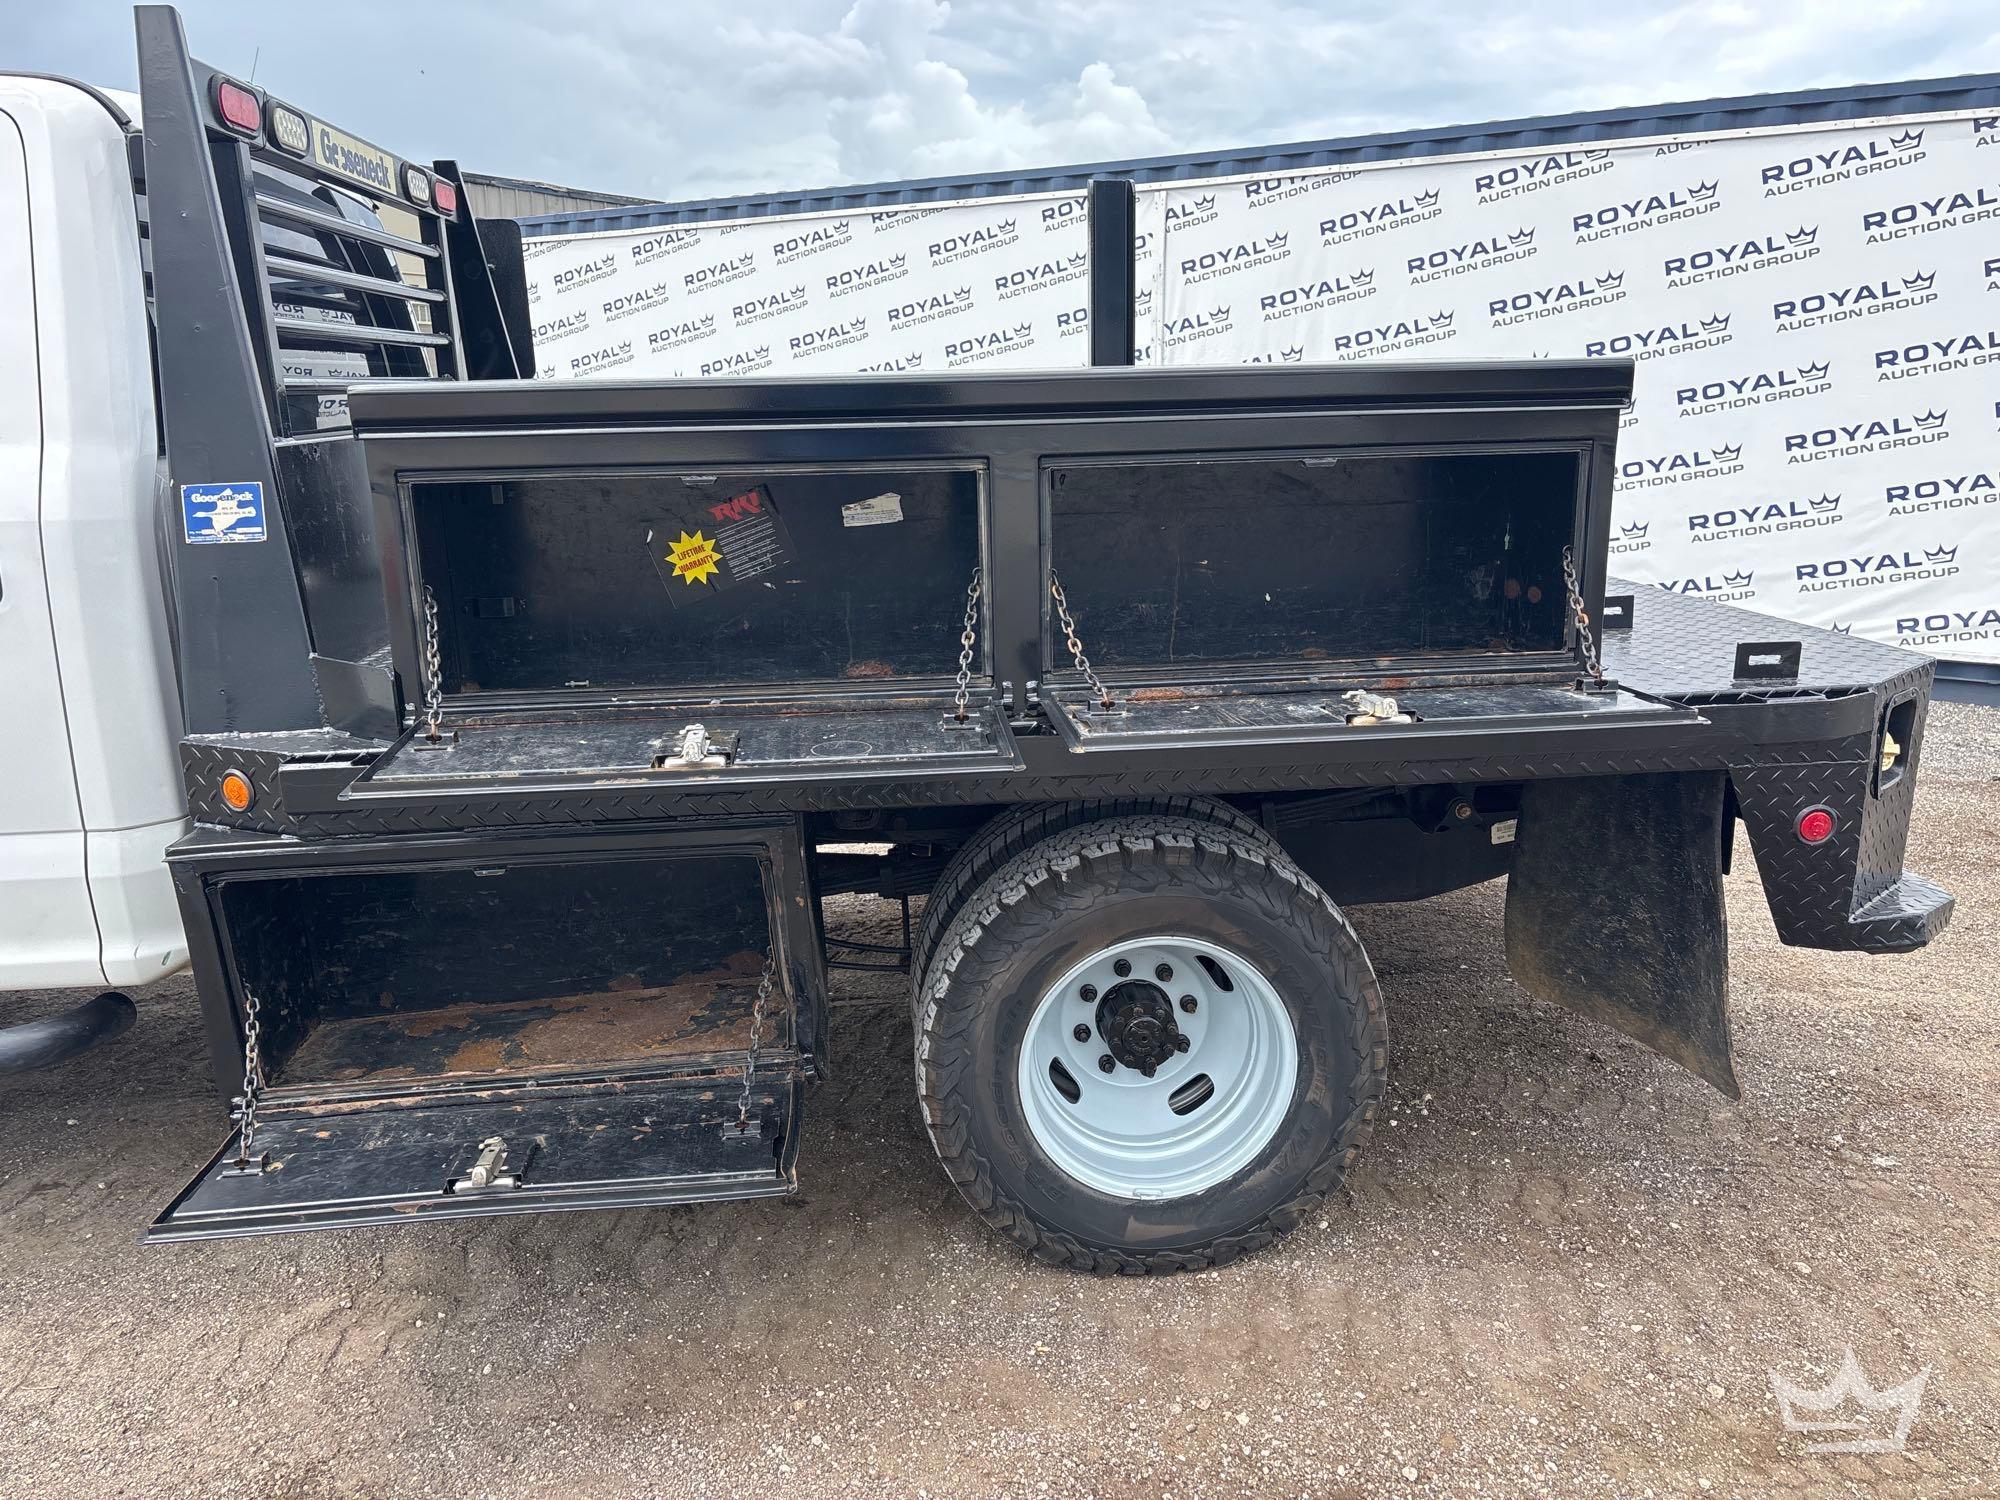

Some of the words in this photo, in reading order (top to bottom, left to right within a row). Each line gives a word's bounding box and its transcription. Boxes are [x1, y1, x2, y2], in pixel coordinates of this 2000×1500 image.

[1475, 152, 1582, 192] ROYAL
[1762, 142, 1888, 184] ROYAL
[1764, 170, 1850, 198] AUCTION
[1856, 152, 1926, 176] GROUP
[1249, 184, 1308, 209] AUCTION
[1479, 178, 1550, 205] AUCTION
[1554, 162, 1614, 184] GROUP
[875, 213, 919, 233] AUCTION
[1042, 197, 1088, 222] ROY
[1045, 214, 1086, 232] AUCTIO
[1174, 212, 1218, 231] GROUP
[1320, 200, 1414, 236] ROYAL
[1574, 192, 1686, 232] ROYAL
[1576, 218, 1652, 244] AUCTION
[1657, 202, 1720, 224] GROUP
[1864, 189, 1997, 231] ROYAL
[1323, 224, 1386, 247] AUCTION
[1390, 208, 1442, 229] GROUP
[1866, 217, 1956, 245] AUCTION
[632, 230, 684, 257] ROYAL
[635, 249, 670, 266] AUCTION
[672, 238, 700, 253] GROUP
[774, 228, 834, 256] ROYAL
[777, 247, 817, 266] AUCTION
[819, 236, 852, 251] GROUP
[929, 227, 998, 257] ROYAL
[932, 248, 978, 267] AUCTION
[980, 235, 1018, 252] GROUP
[1408, 238, 1507, 274] ROYAL
[1182, 242, 1266, 274] ROYAL
[1184, 264, 1241, 285] AUCTION
[1244, 250, 1290, 268] GROUP
[1411, 262, 1478, 285] AUCTION
[1482, 248, 1537, 268] GROUP
[1665, 237, 1784, 276] ROYAL
[1668, 264, 1748, 289] AUCTION
[1754, 248, 1820, 269] GROUP
[554, 261, 602, 286] ROYAL
[557, 278, 589, 294] AUCTION
[590, 268, 617, 282] GROUP
[684, 260, 739, 286] ROYAL
[688, 278, 724, 295] AUCTION
[726, 267, 756, 282] GROUP
[826, 262, 889, 289] ROYAL
[830, 280, 872, 299] AUCTION
[874, 269, 908, 285] GROUP
[996, 260, 1068, 290] ROYAL
[999, 281, 1047, 301] AUCTION
[1050, 269, 1088, 286] GROUP
[603, 290, 653, 314] ROYAL
[733, 292, 790, 318] ROYAL
[888, 294, 954, 322] ROYAL
[1261, 278, 1350, 310] ROYAL
[1264, 300, 1324, 322] AUCTION
[1327, 288, 1376, 306] GROUP
[1489, 281, 1594, 316] ROYAL
[1774, 282, 1900, 320] ROYAL
[606, 307, 640, 322] AUCTION
[641, 297, 668, 310] GROUP
[736, 311, 774, 328] AUCTION
[776, 300, 808, 315] GROUP
[892, 313, 935, 331] AUCTION
[937, 302, 974, 318] GROUP
[1492, 306, 1563, 328] AUCTION
[1567, 291, 1626, 311] GROUP
[1776, 308, 1862, 333] AUCTION
[1868, 293, 1937, 314] GROUP
[564, 324, 589, 336] GROUP
[649, 321, 700, 345] ROYAL
[790, 324, 850, 350] ROYAL
[1163, 315, 1208, 334] YAL
[1189, 324, 1232, 341] GROUP
[1335, 320, 1428, 351] ROYAL
[652, 338, 686, 354] AUCTION
[688, 328, 716, 342] GROUP
[793, 342, 833, 359] AUCTION
[835, 332, 868, 347] GROUP
[945, 330, 1013, 357] ROYAL
[948, 350, 994, 368] AUCTION
[996, 339, 1034, 354] GROUP
[1339, 342, 1401, 360] AUCTION
[1404, 330, 1456, 347] GROUP
[1586, 324, 1699, 357] ROYAL
[1669, 335, 1732, 354] GROUP
[571, 347, 619, 370] ROYAL
[574, 364, 606, 378] AUCTION
[608, 354, 634, 367] GROUP
[701, 352, 755, 376] ROYAL
[1878, 358, 1968, 382] AUCTION
[1677, 371, 1796, 405] ROYAL
[1680, 396, 1760, 417] AUCTION
[1765, 383, 1831, 402] GROUP
[1786, 418, 1912, 452] ROYAL
[1788, 443, 1873, 464] AUCTION
[1879, 431, 1949, 450] GROUP
[1613, 475, 1677, 492] UCTION
[1681, 464, 1744, 481] GROUP
[1886, 474, 1996, 503] ROYA
[1689, 502, 1807, 530] ROYAL
[1889, 496, 1978, 516] AUCTION
[1692, 525, 1771, 543] AUCTION
[1776, 515, 1842, 531] GROUP
[677, 545, 705, 561] LIFETIME
[679, 554, 714, 574] WARRANTY
[1796, 552, 1922, 580] ROYAL
[1799, 576, 1884, 592] AUCTION
[1890, 566, 1959, 582] GROUP
[1897, 610, 2000, 634] ROYA
[1899, 630, 1988, 646] AUCTION
